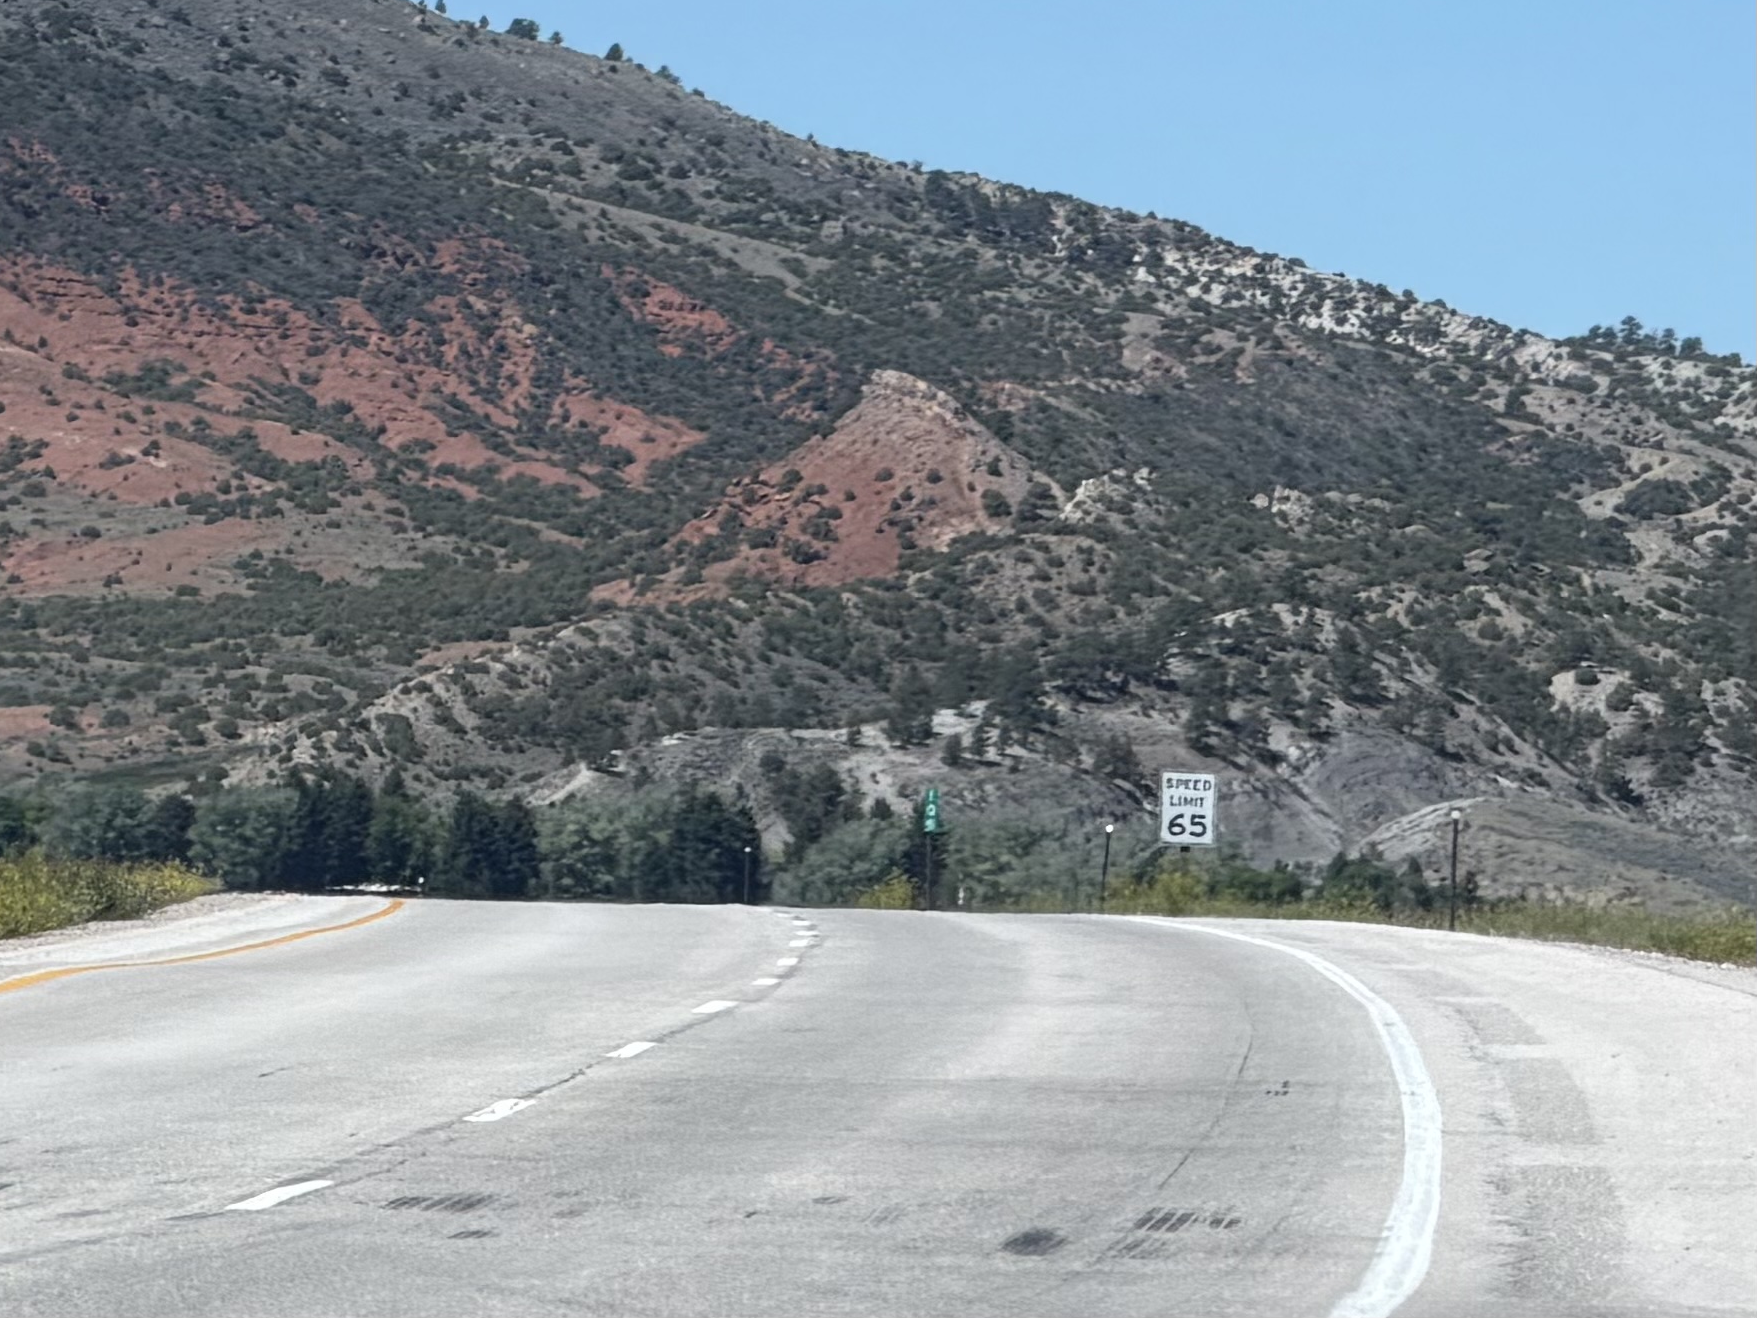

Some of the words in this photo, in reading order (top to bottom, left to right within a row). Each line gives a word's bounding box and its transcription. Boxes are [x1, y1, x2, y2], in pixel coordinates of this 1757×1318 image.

[1166, 777, 1212, 792] SPEED
[1169, 794, 1205, 808] LIMIT
[1168, 813, 1207, 837] 65
